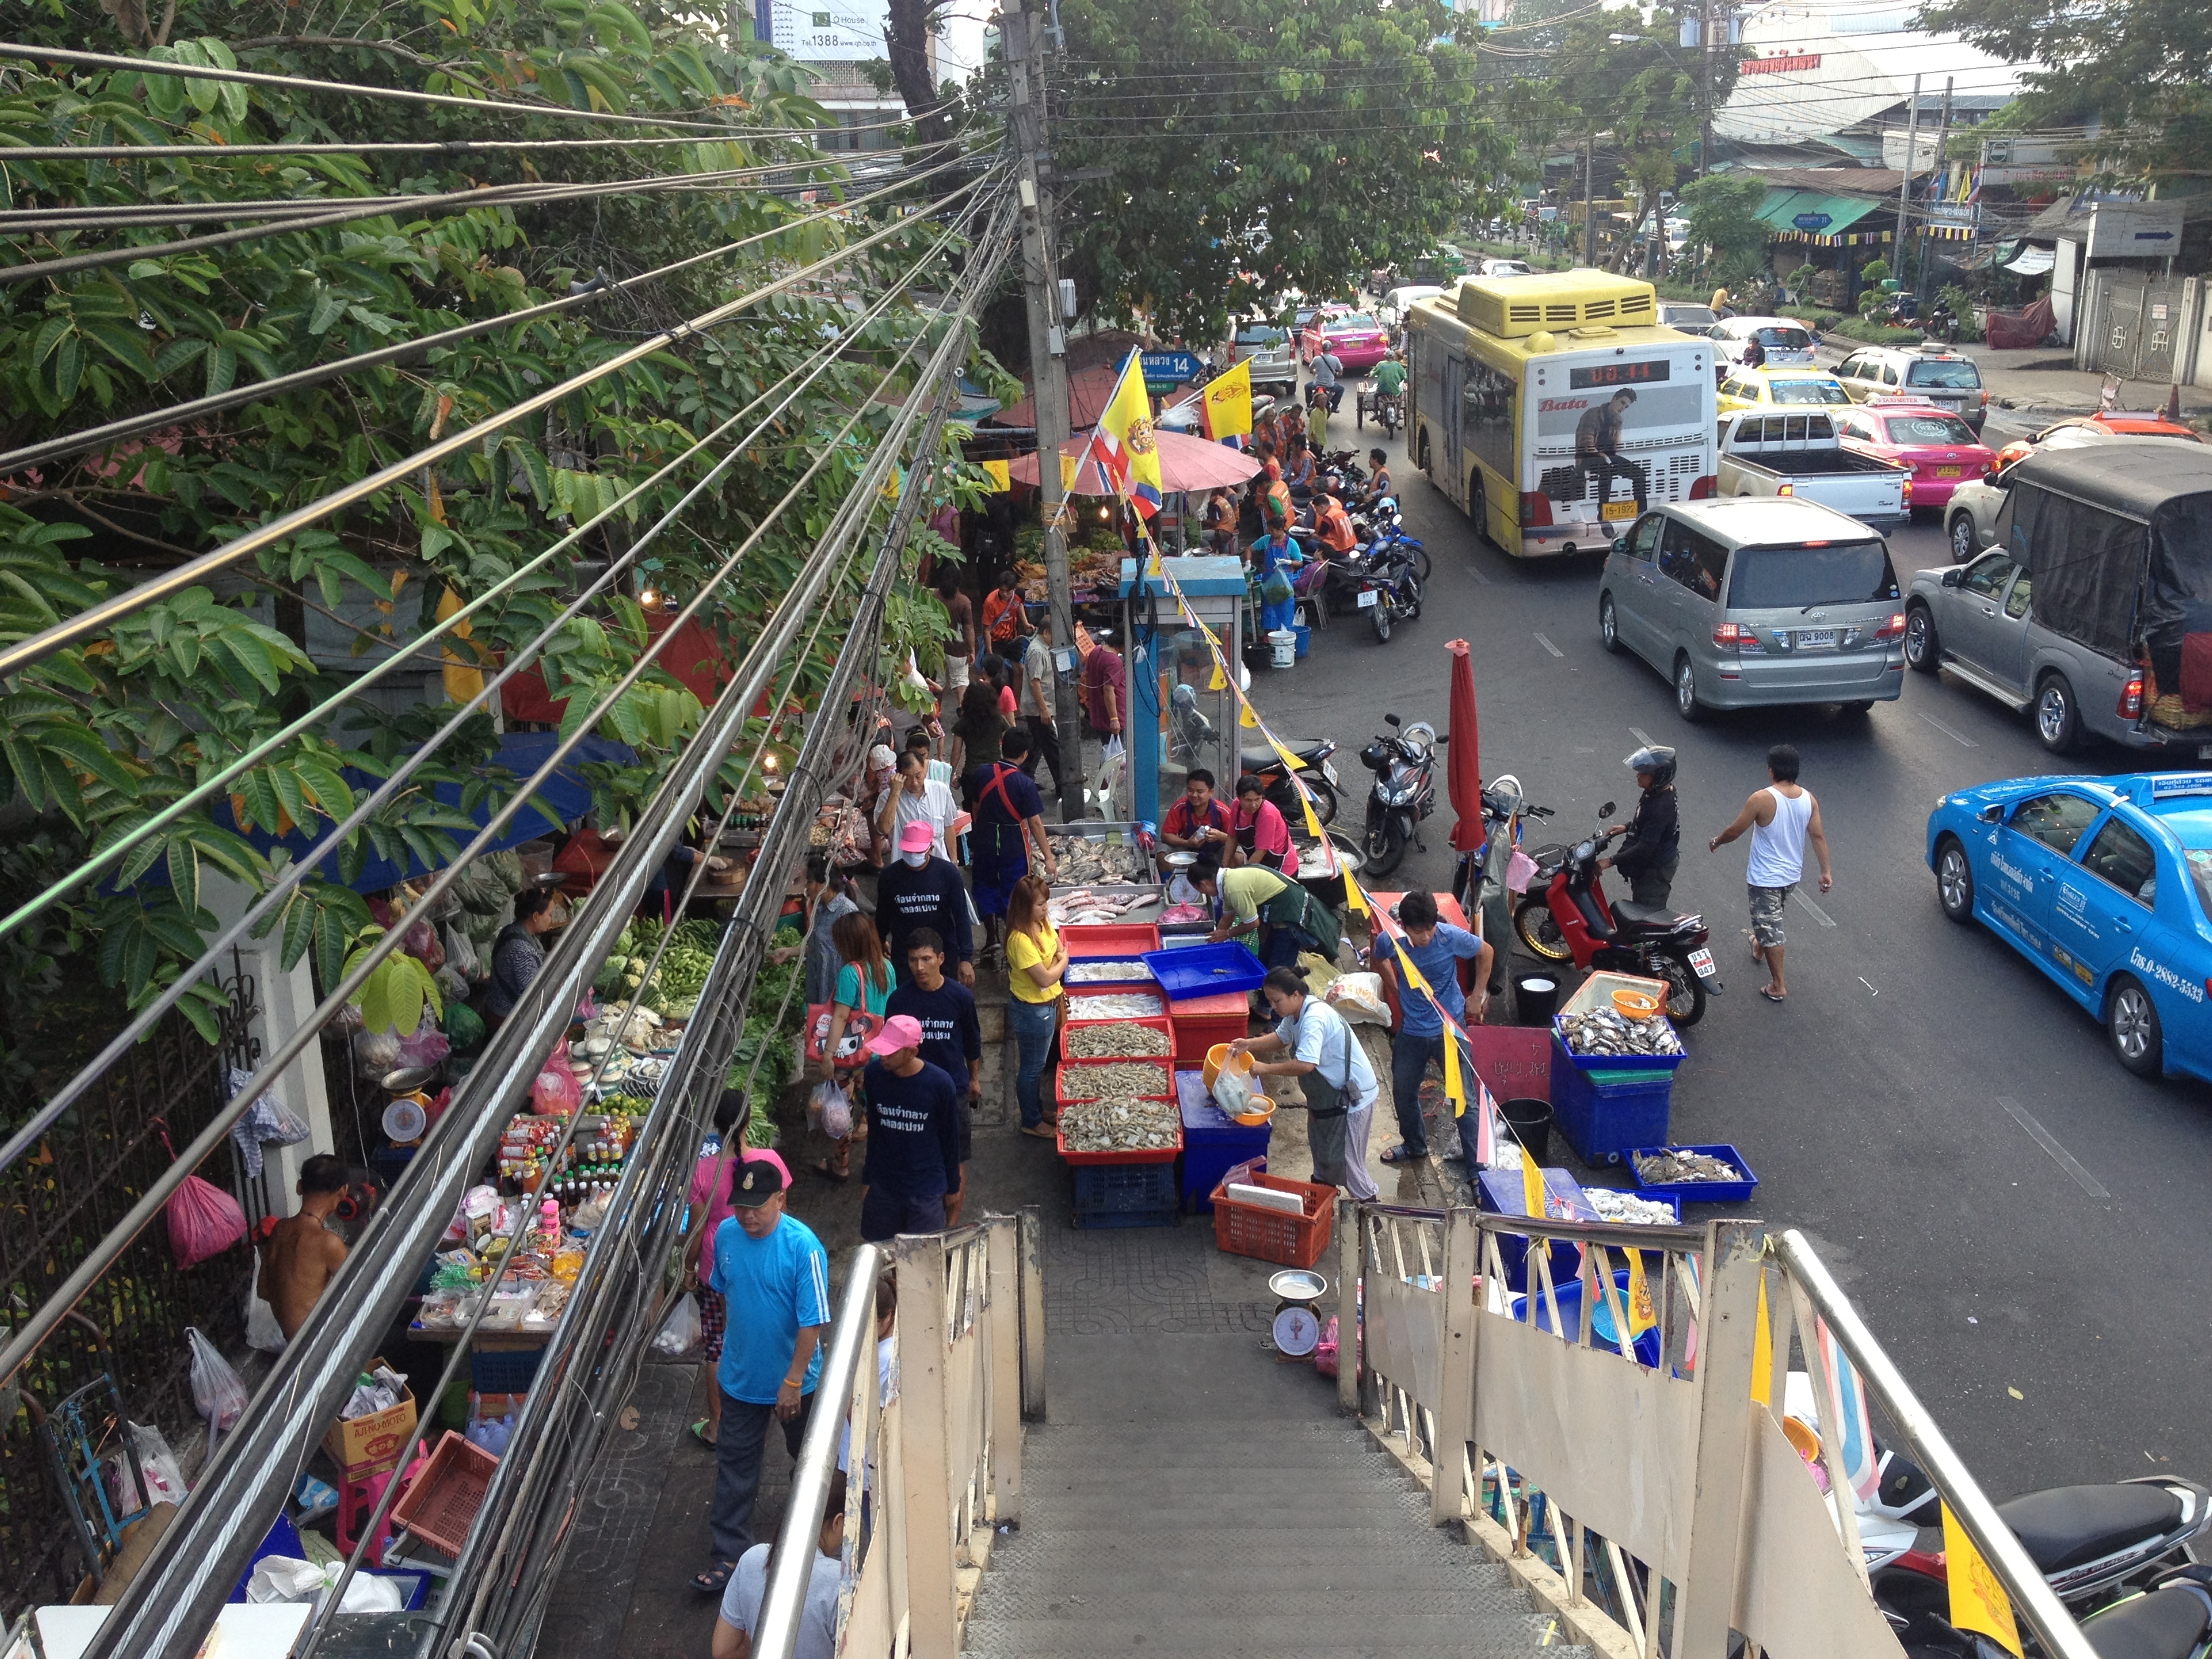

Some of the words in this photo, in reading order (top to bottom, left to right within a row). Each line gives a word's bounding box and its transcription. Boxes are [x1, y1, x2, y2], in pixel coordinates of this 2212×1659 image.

[1173, 358, 1189, 372] 14
[1538, 398, 1589, 412] Bata
[1814, 631, 1834, 640] 9008
[894, 893, 941, 903] เรือนจำกลาง
[1698, 964, 1713, 976] 947
[876, 1103, 929, 1120] เรือนจำกลาง
